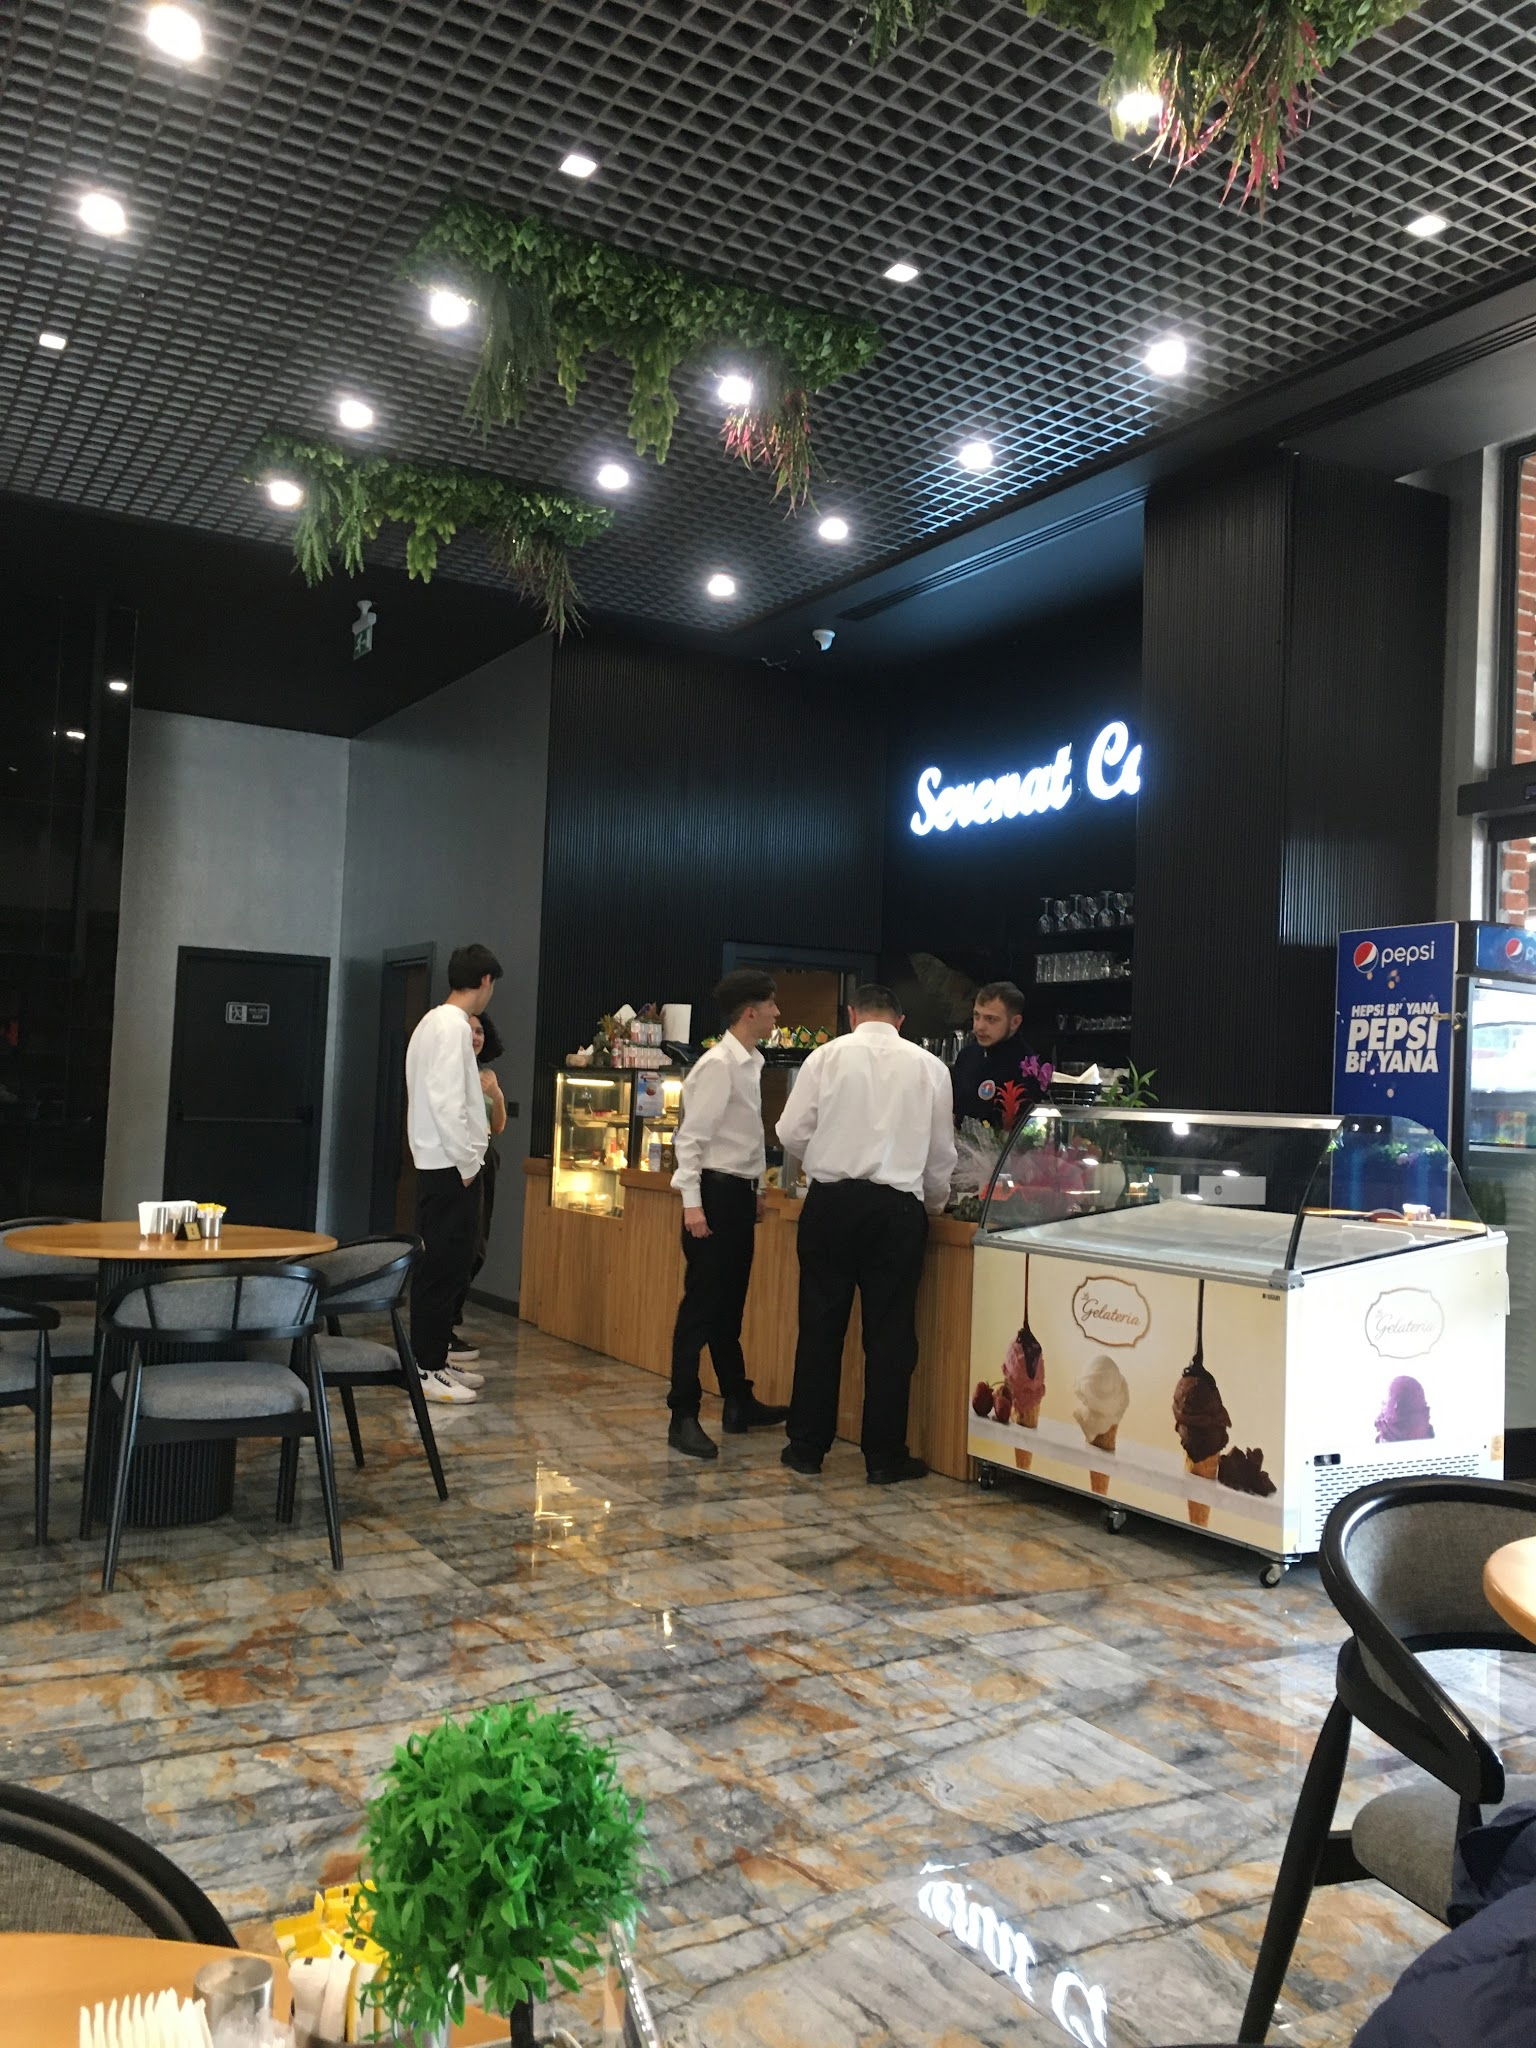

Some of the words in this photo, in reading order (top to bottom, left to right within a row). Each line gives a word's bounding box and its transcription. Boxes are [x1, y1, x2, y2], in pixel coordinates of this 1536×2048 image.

[911, 742, 1072, 836] Serenat
[1381, 940, 1435, 968] pepsi
[1406, 1002, 1440, 1015] YANA
[1347, 1016, 1439, 1050] PEPSI
[1377, 1050, 1439, 1073] YANA
[1081, 1298, 1140, 1325] Gelateria
